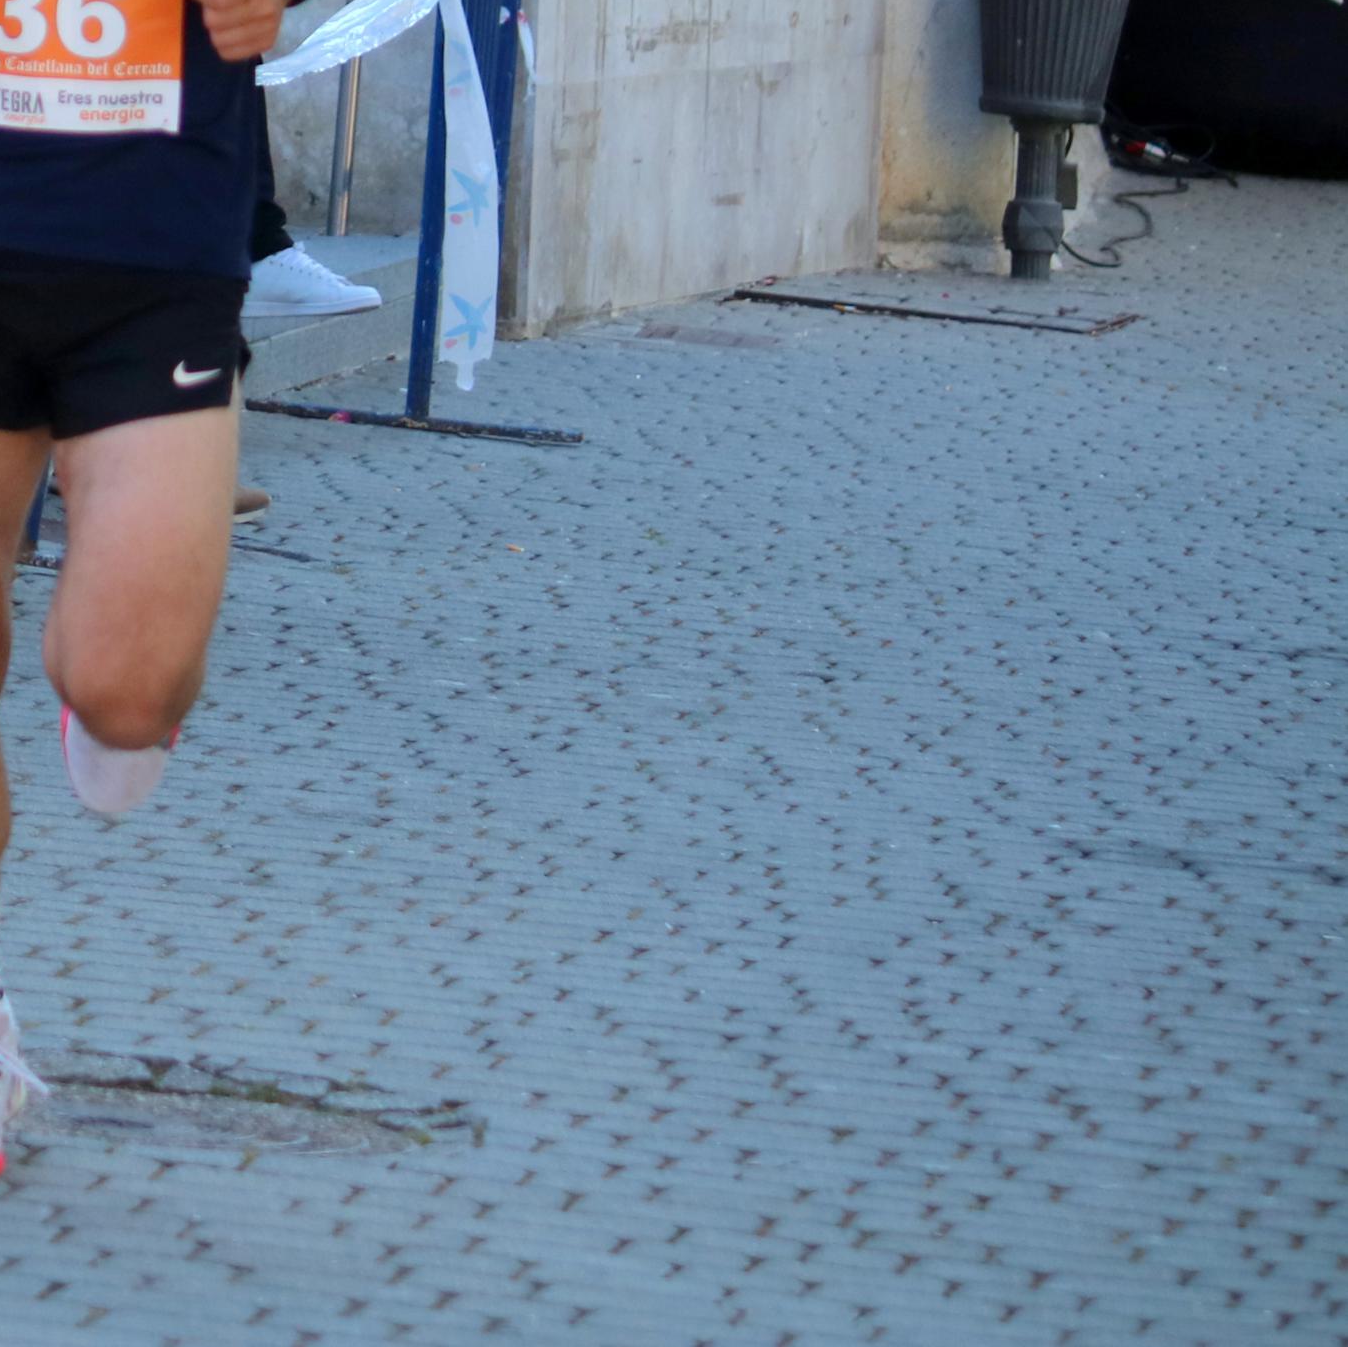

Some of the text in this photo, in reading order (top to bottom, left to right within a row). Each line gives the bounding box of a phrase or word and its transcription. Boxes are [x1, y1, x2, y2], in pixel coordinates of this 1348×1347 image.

[5, 54, 82, 75] Castellana
[87, 60, 108, 76] del
[113, 61, 172, 77] Cerrato
[57, 89, 93, 106] Eres
[98, 90, 163, 106] nuestra
